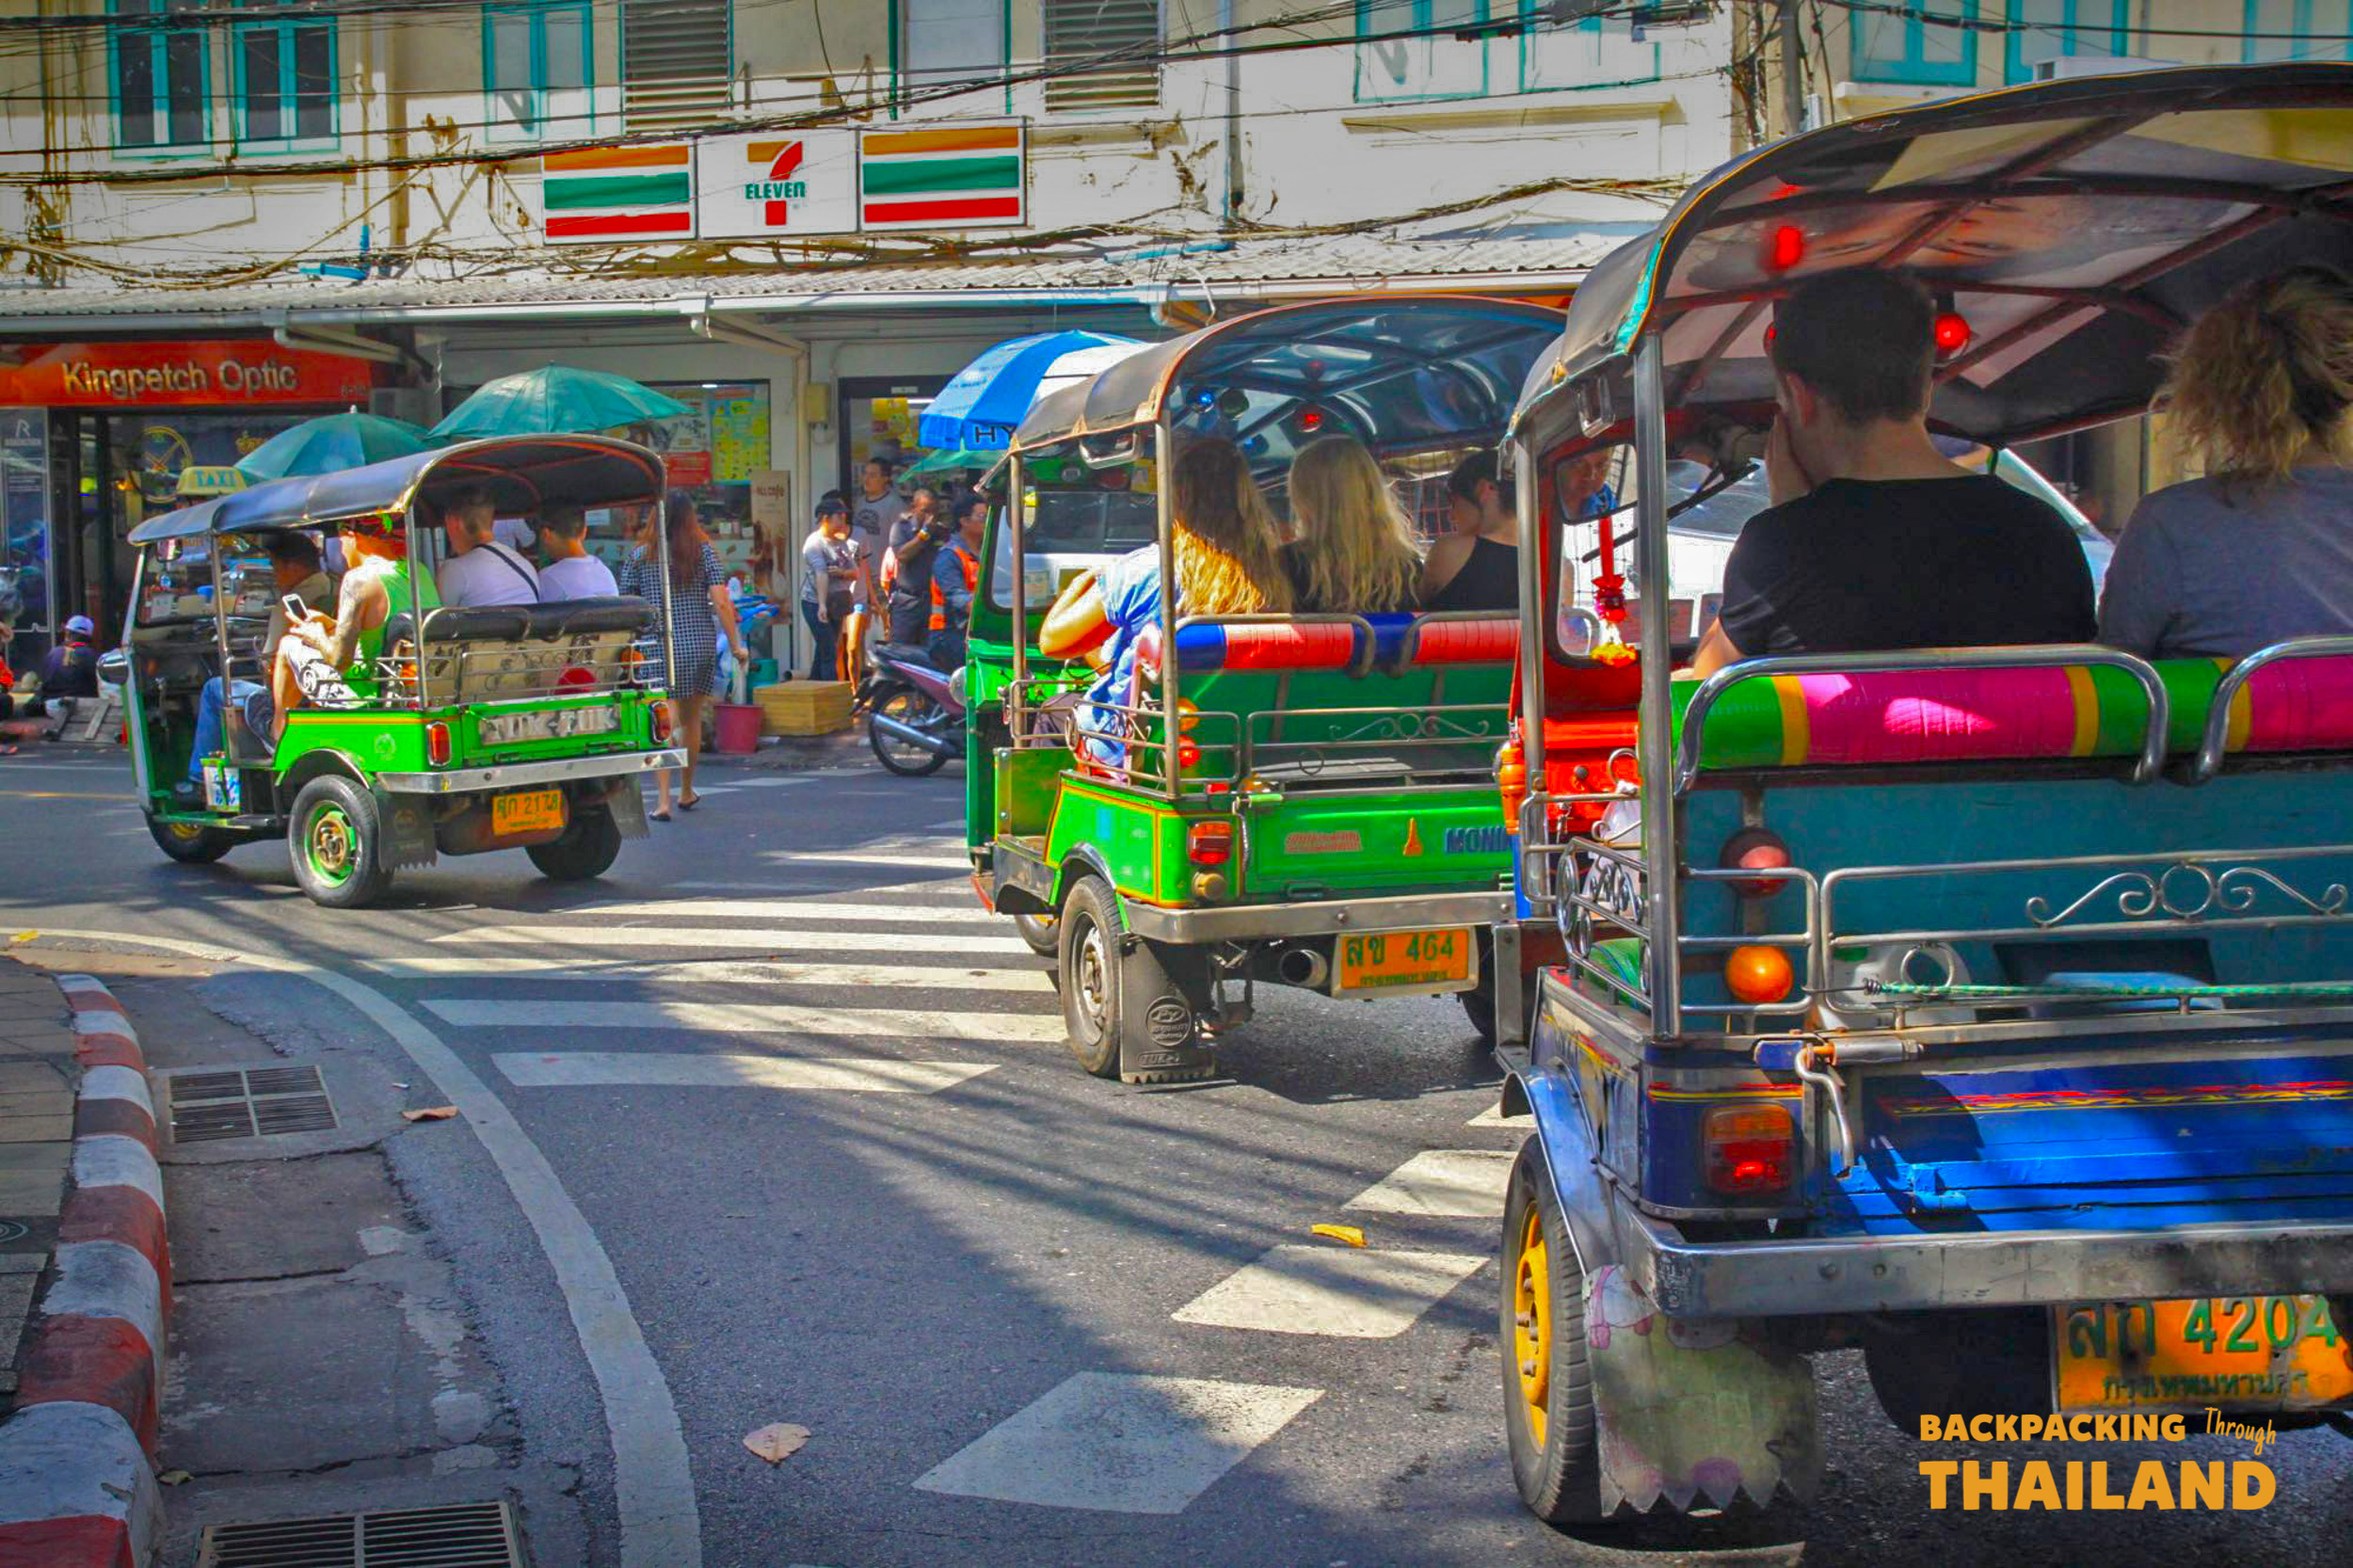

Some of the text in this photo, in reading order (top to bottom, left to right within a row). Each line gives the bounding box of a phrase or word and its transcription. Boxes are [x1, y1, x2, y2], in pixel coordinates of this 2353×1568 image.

[747, 140, 803, 180] 7
[62, 360, 296, 399] Kingpetch Optic
[194, 470, 236, 488] TAXI
[1406, 931, 1453, 962] 464
